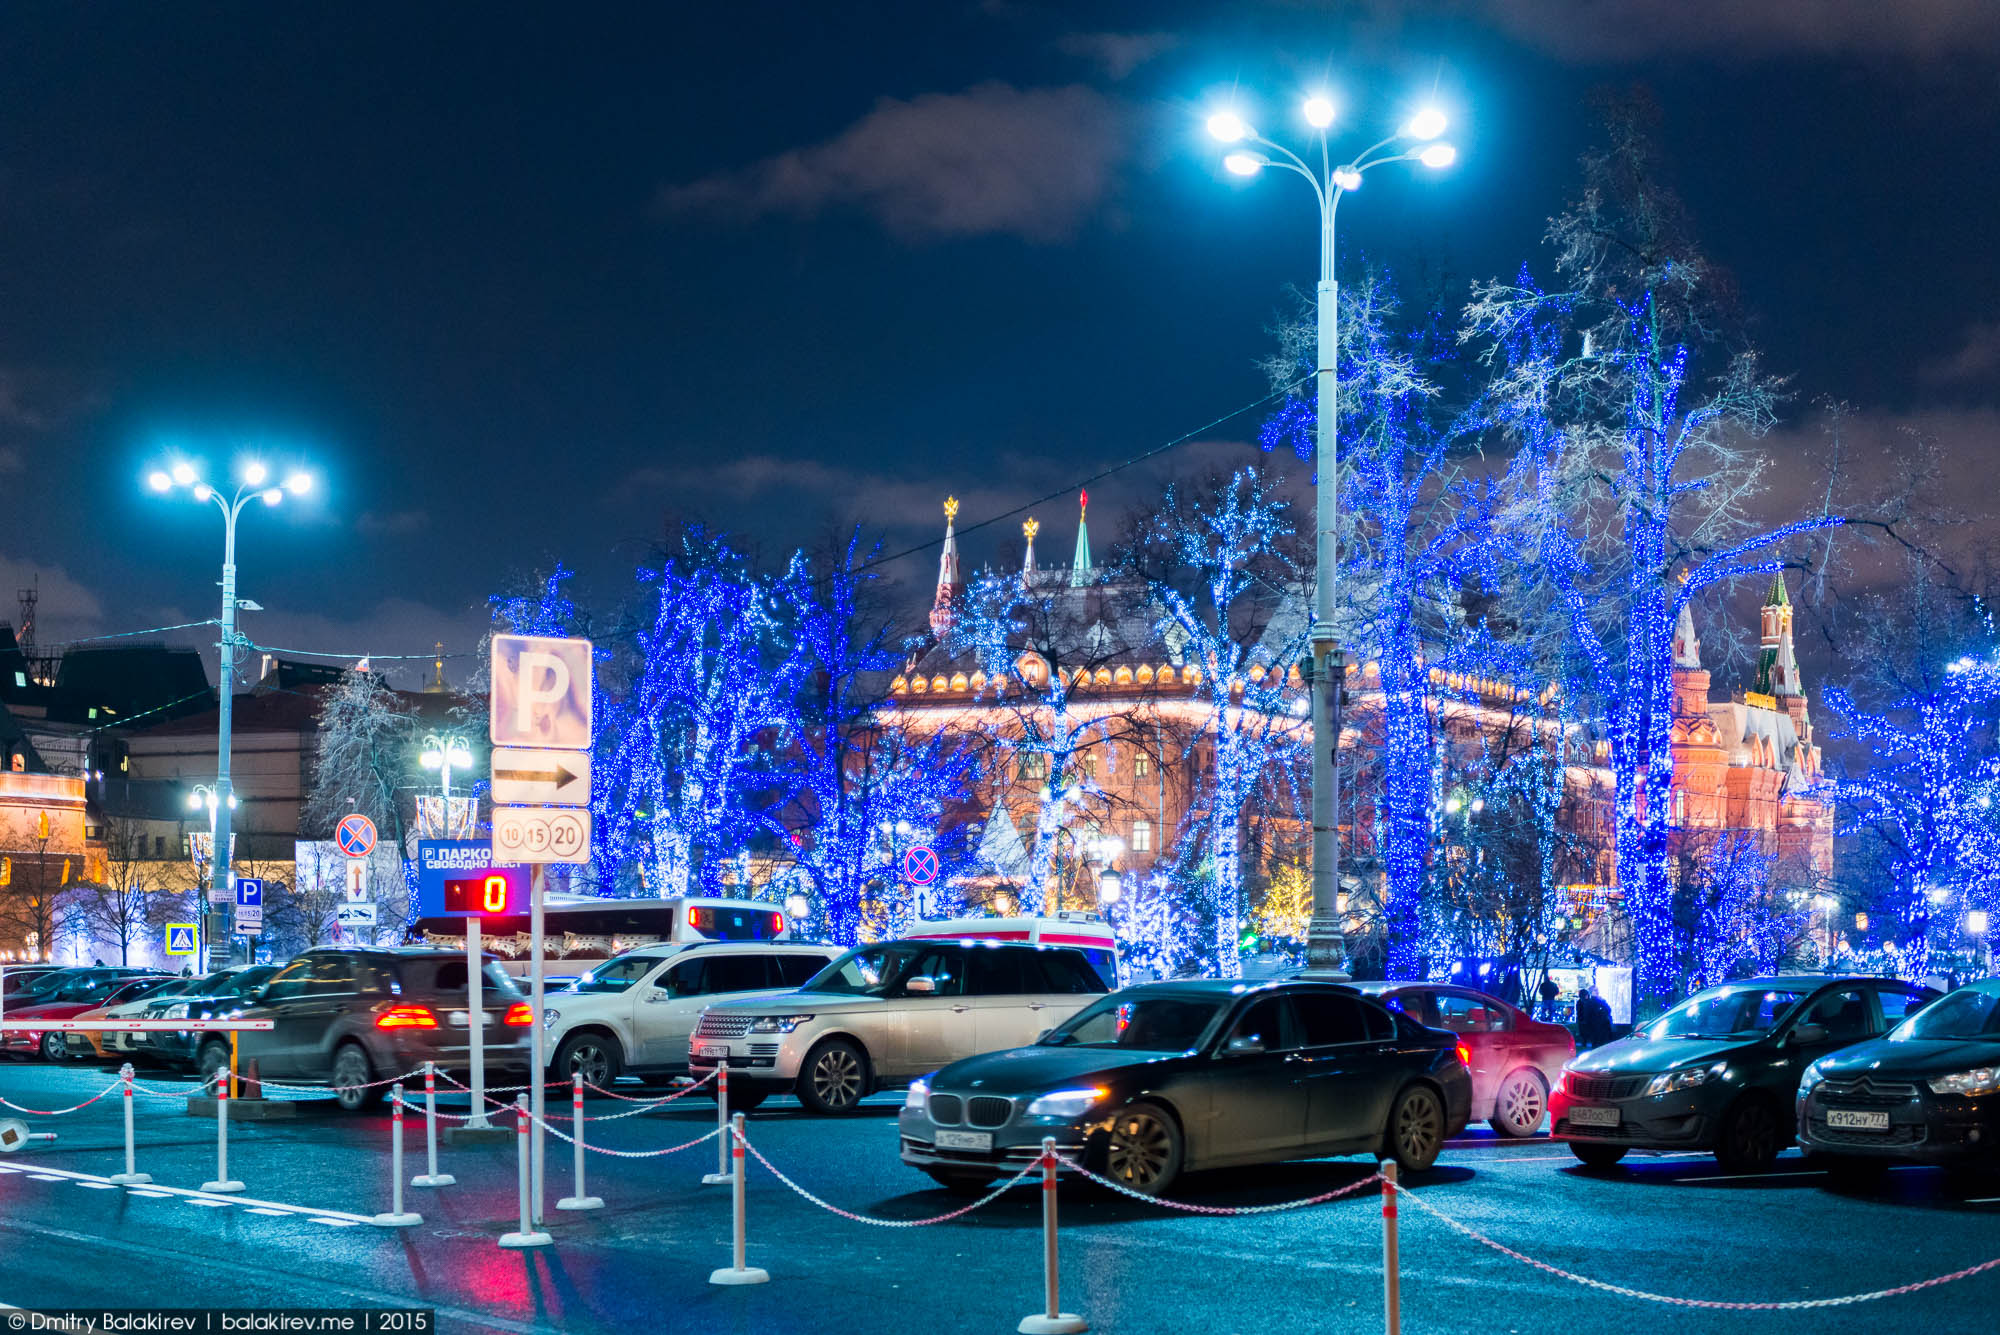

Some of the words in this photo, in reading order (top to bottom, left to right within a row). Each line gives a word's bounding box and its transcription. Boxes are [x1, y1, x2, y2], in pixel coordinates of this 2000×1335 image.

[517, 651, 570, 733] P
[505, 828, 519, 841] 10
[528, 828, 544, 843] 15
[555, 826, 575, 844] 20
[438, 848, 492, 861] ПАРКО
[426, 860, 488, 870] СВОБОДНО
[243, 881, 258, 903] P
[484, 875, 506, 912] 0
